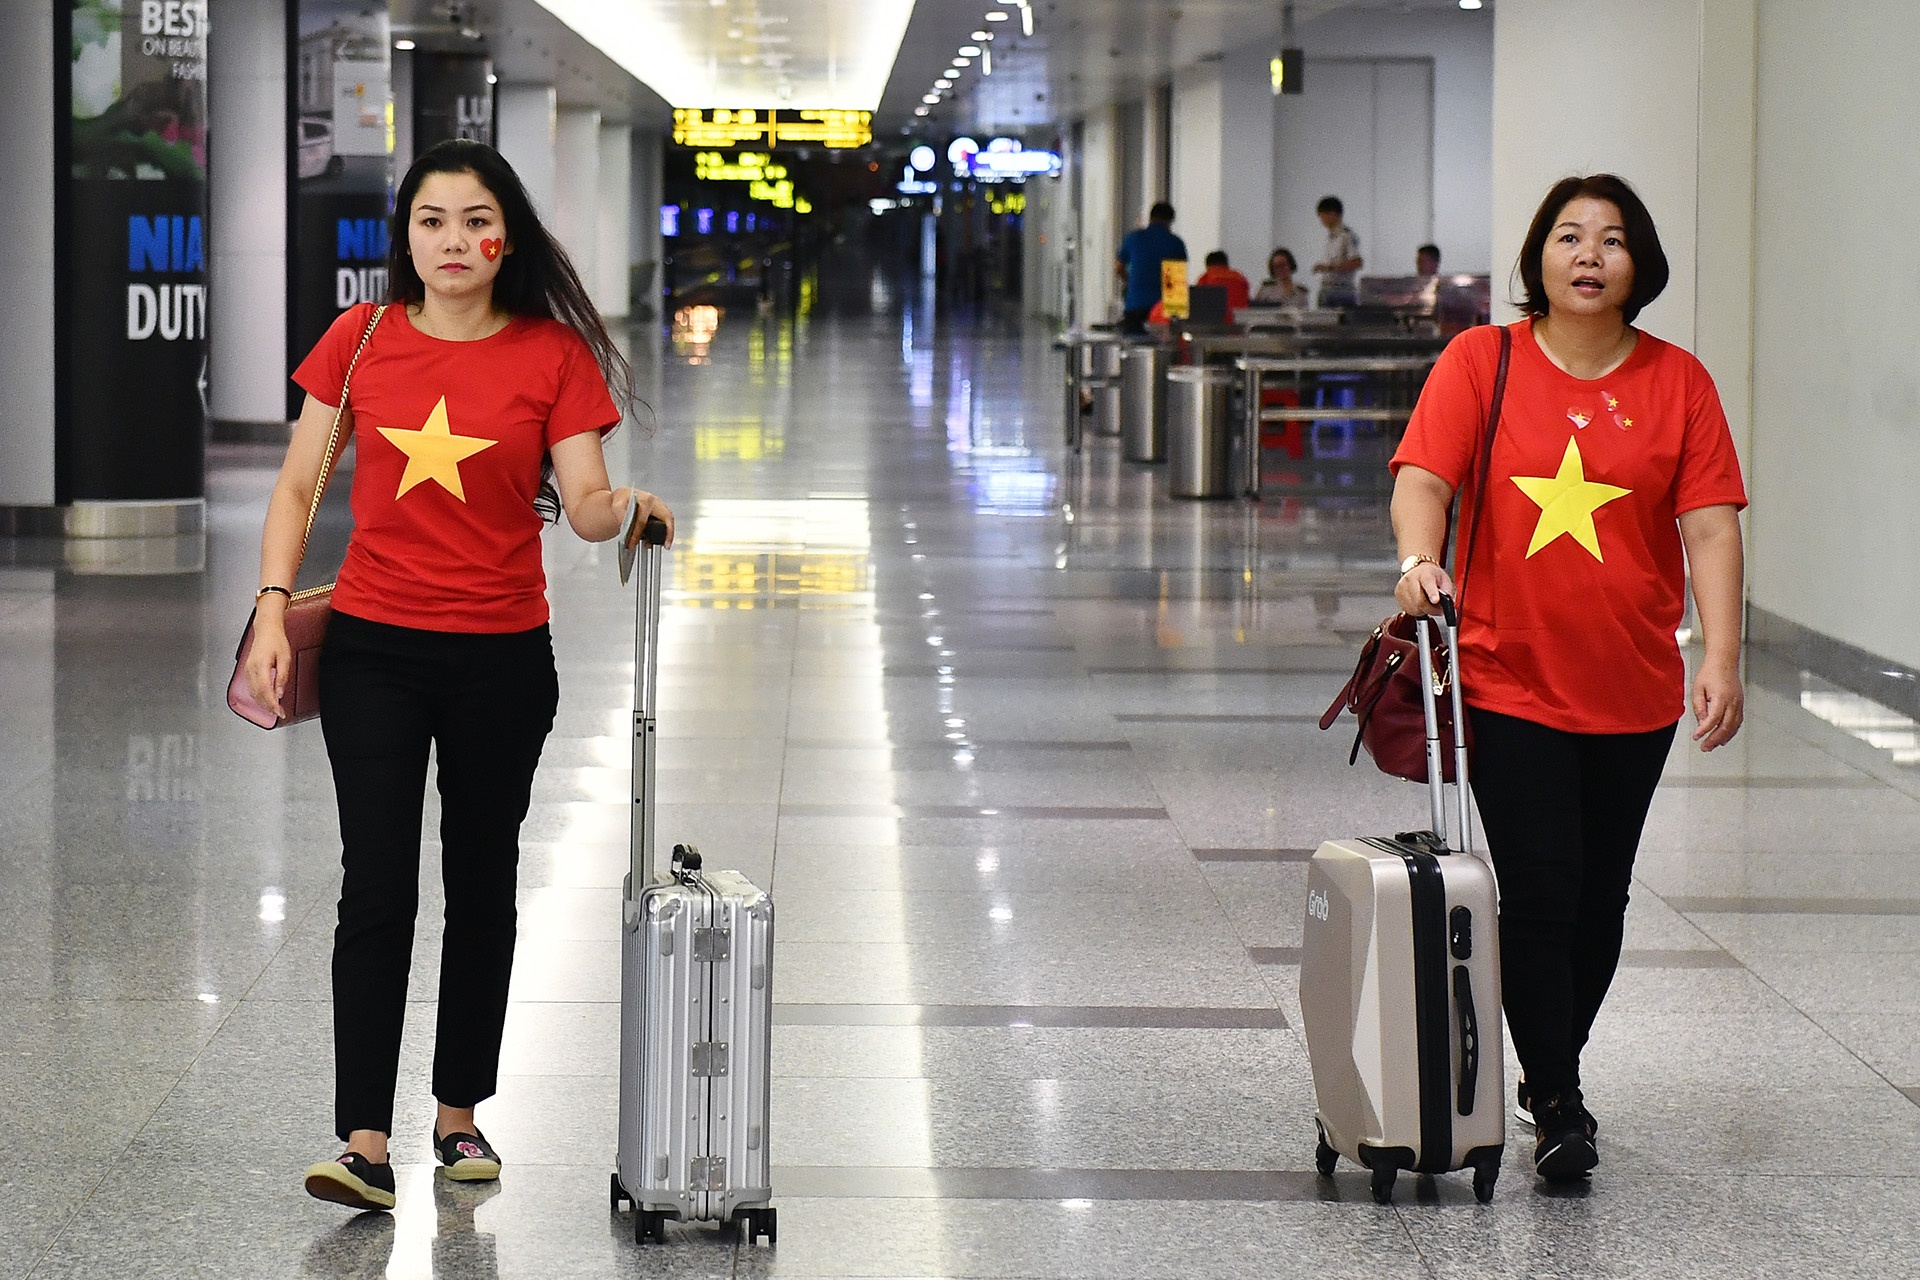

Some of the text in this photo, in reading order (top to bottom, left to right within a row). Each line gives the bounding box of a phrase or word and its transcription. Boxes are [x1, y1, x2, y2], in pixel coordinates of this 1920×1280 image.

[142, 38, 166, 56] ON
[128, 214, 204, 272] NIA
[1309, 889, 1329, 921] Grab
